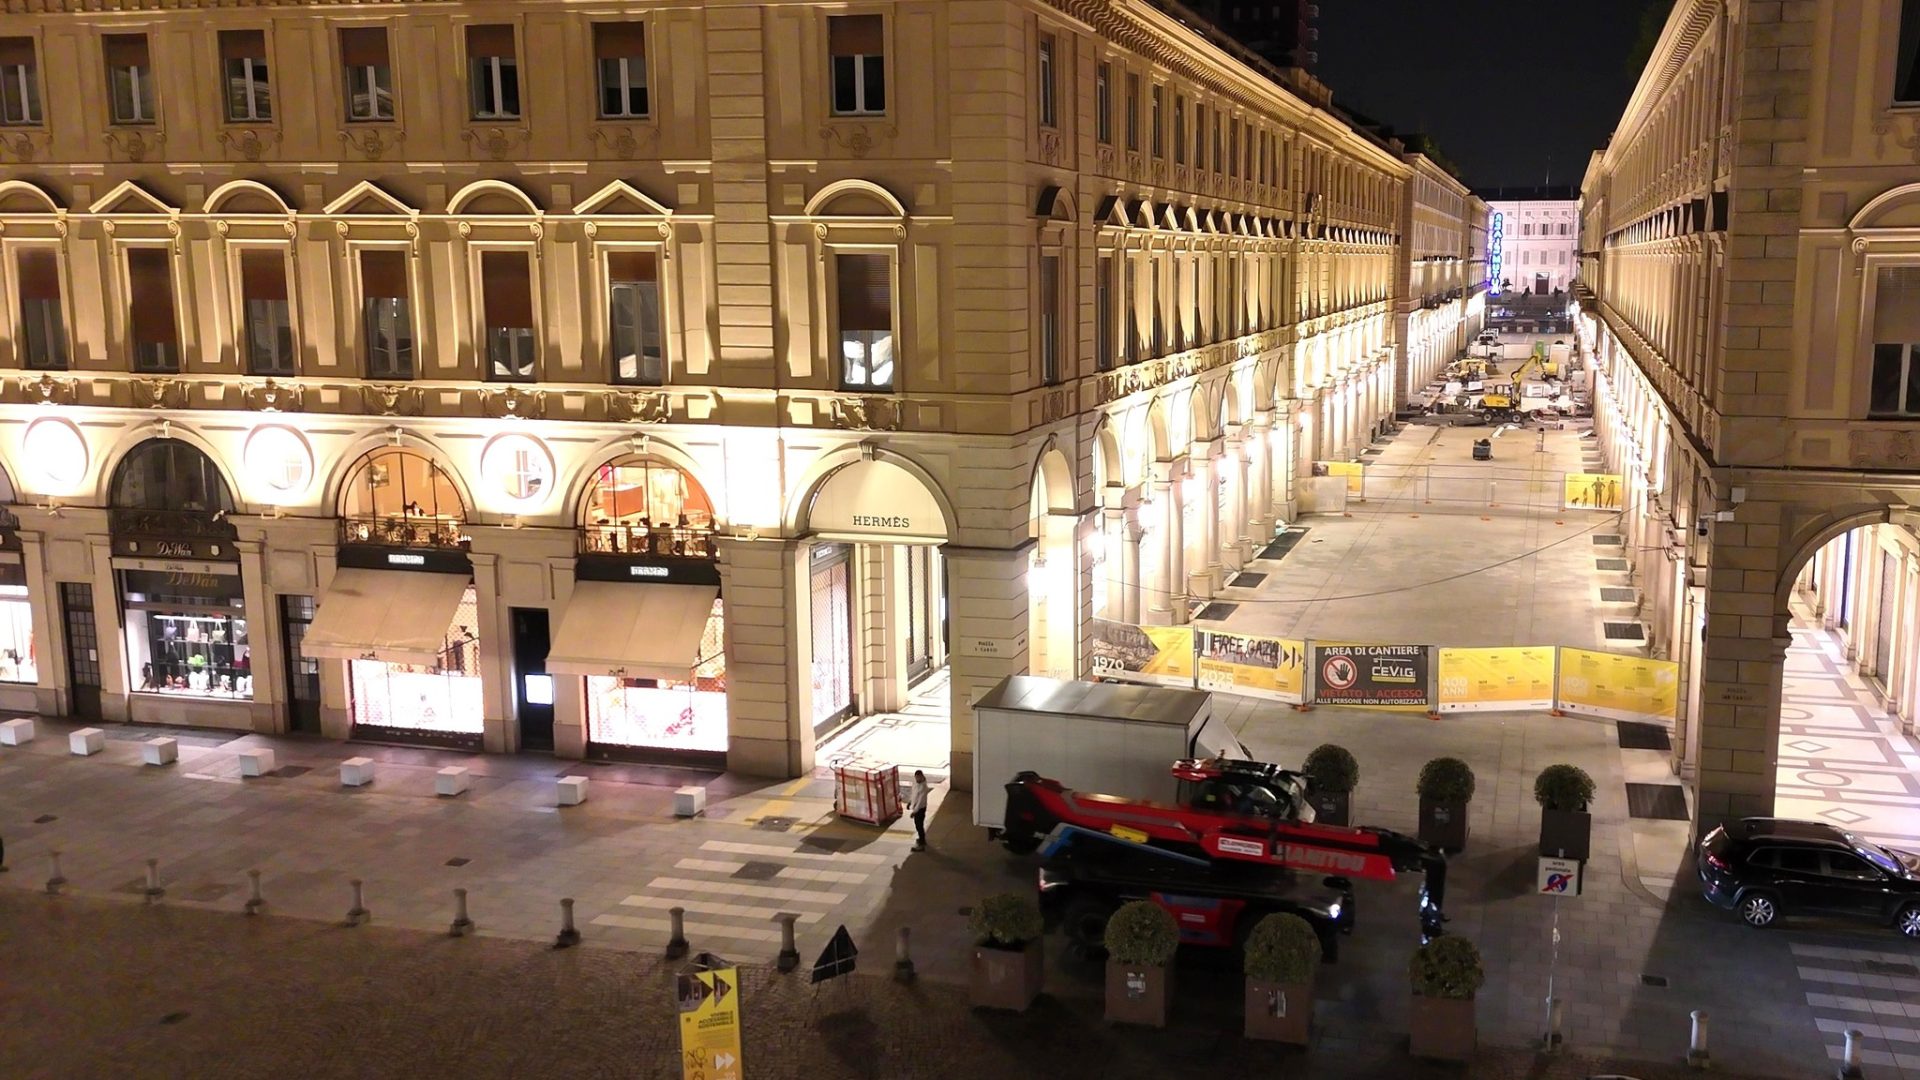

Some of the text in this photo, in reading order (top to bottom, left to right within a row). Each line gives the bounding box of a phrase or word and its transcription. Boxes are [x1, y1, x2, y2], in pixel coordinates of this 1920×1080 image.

[1212, 634, 1244, 654] FREE
[1324, 646, 1419, 656] AREA DI CANTIERE
[1093, 656, 1125, 670] 1970
[1320, 689, 1363, 698] VIETATO
[1376, 689, 1423, 698] ACCESSO
